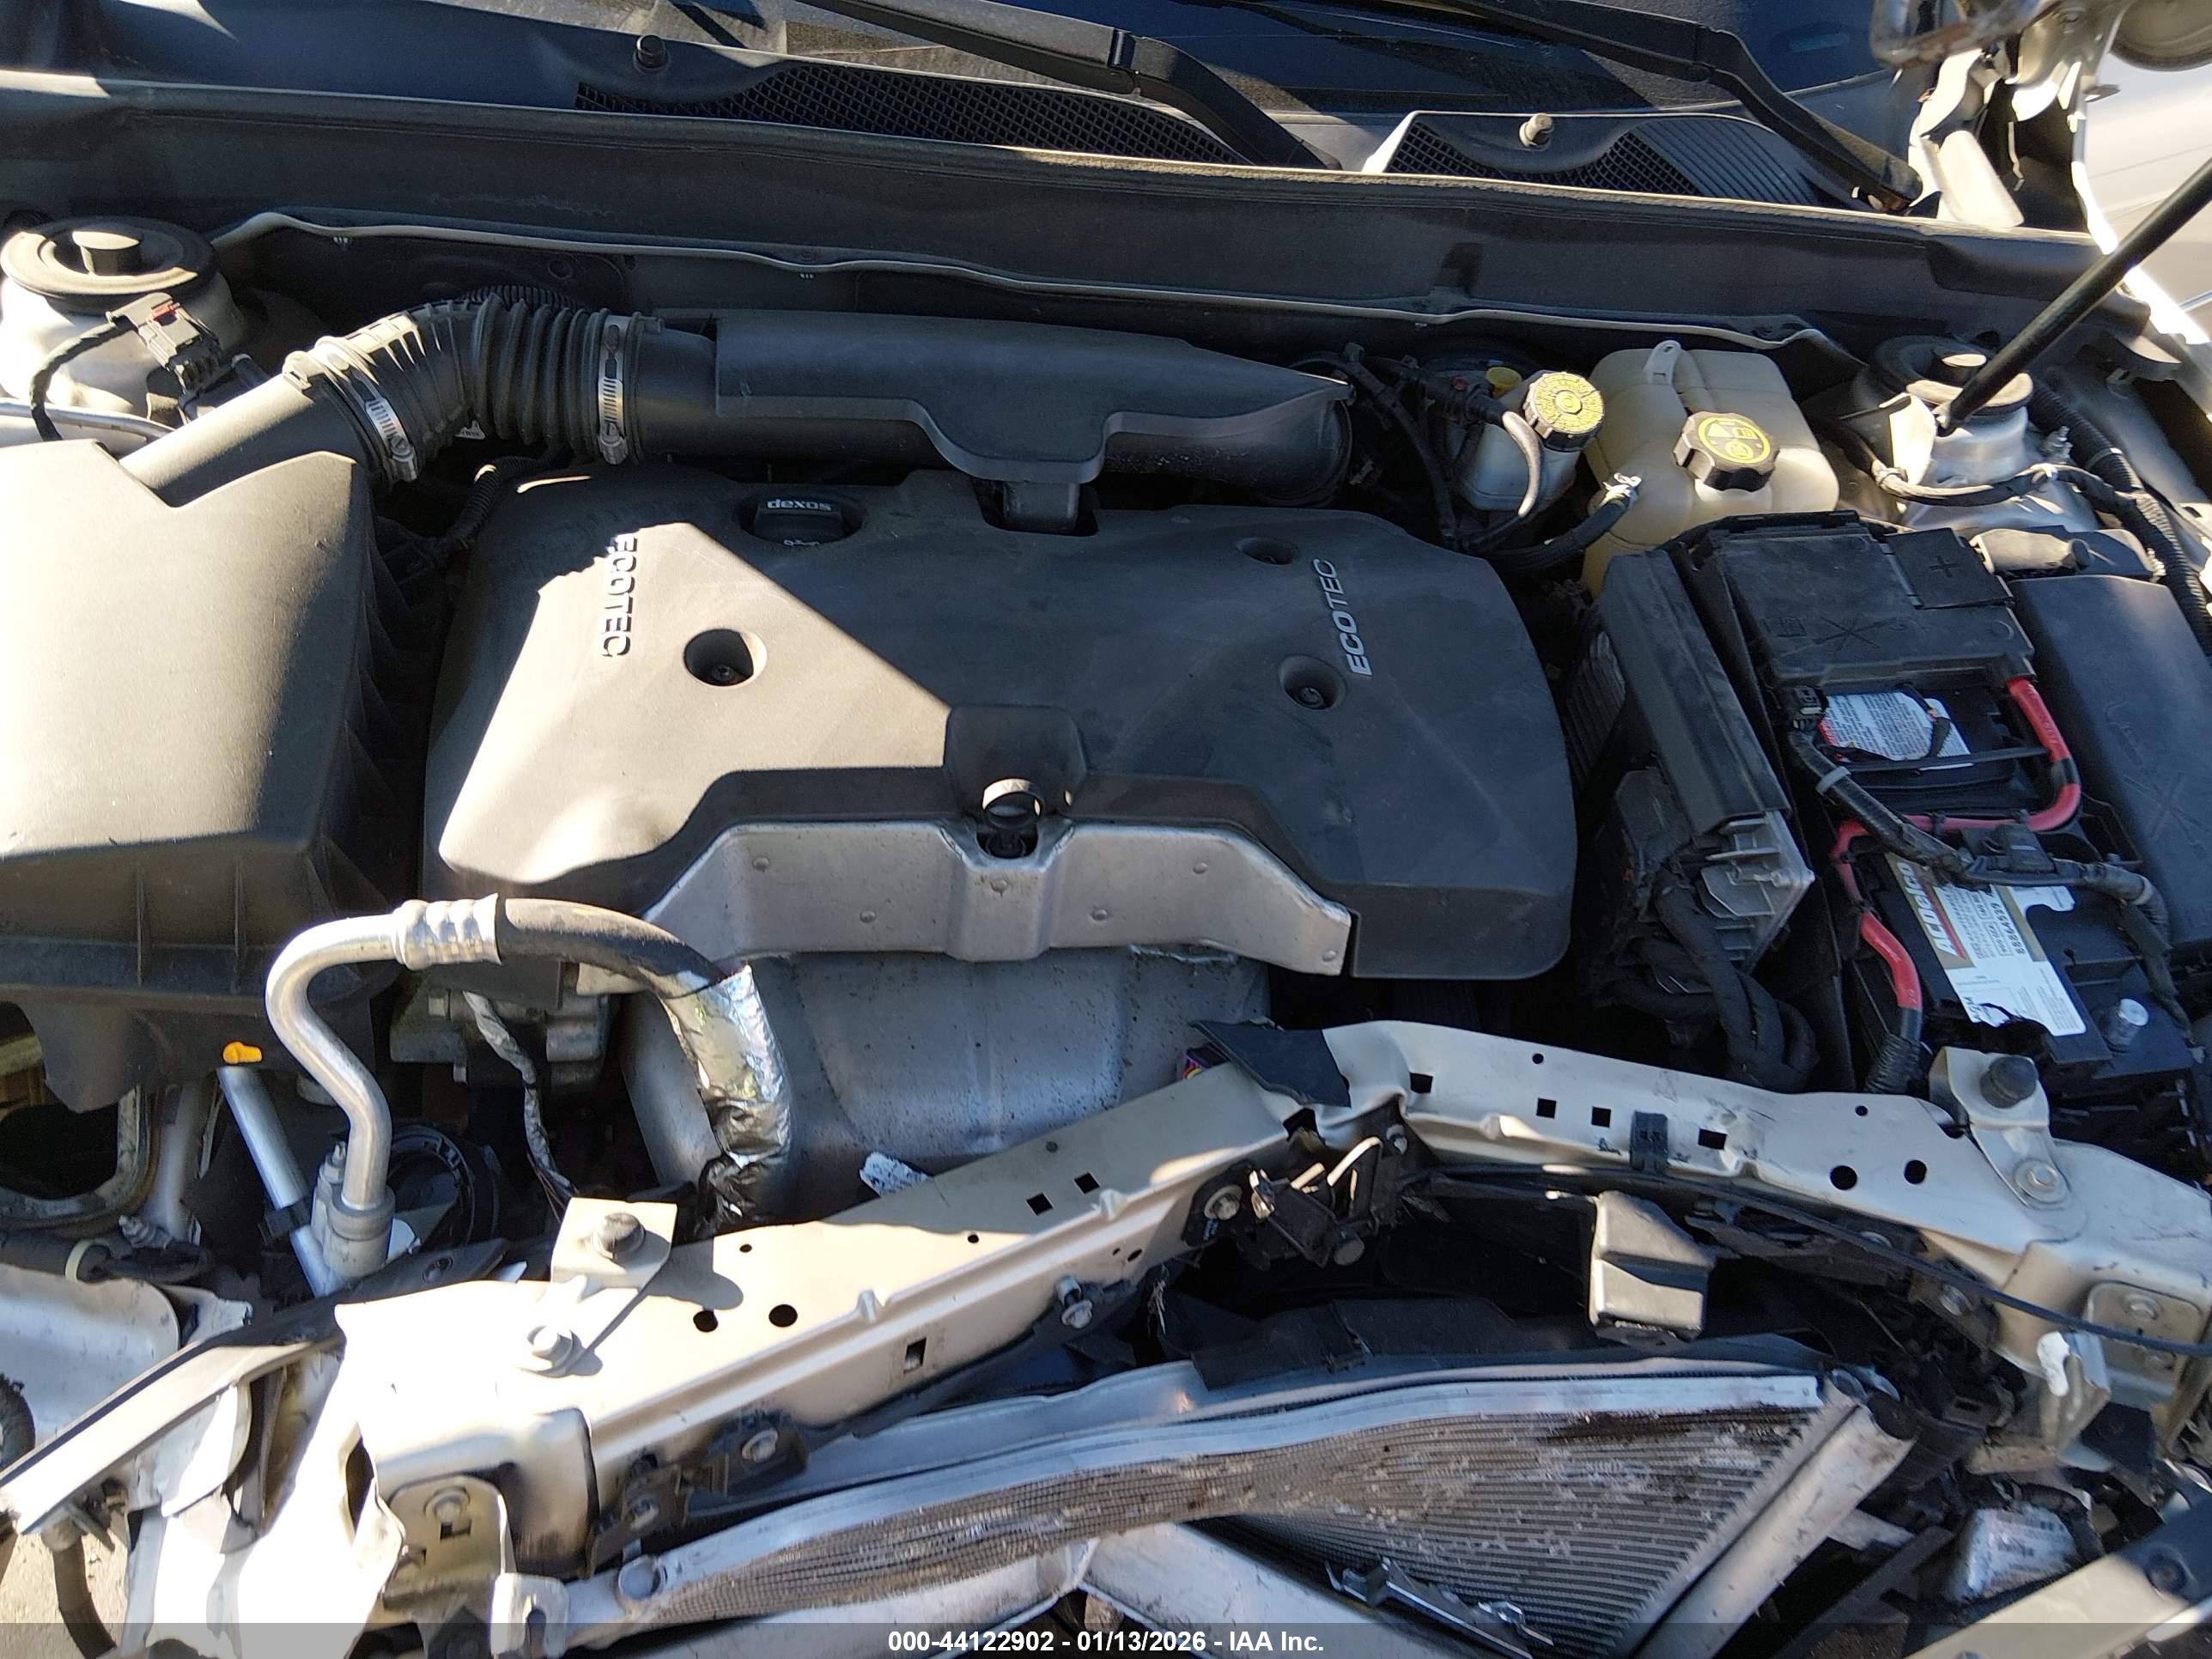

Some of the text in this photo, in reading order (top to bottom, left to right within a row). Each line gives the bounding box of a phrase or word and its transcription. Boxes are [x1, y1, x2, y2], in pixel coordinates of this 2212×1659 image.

[767, 498, 832, 511] dexos
[600, 533, 638, 658] ECOTEC
[1313, 558, 1374, 676] ECOTEC
[1896, 861, 1959, 957] ACDelco
